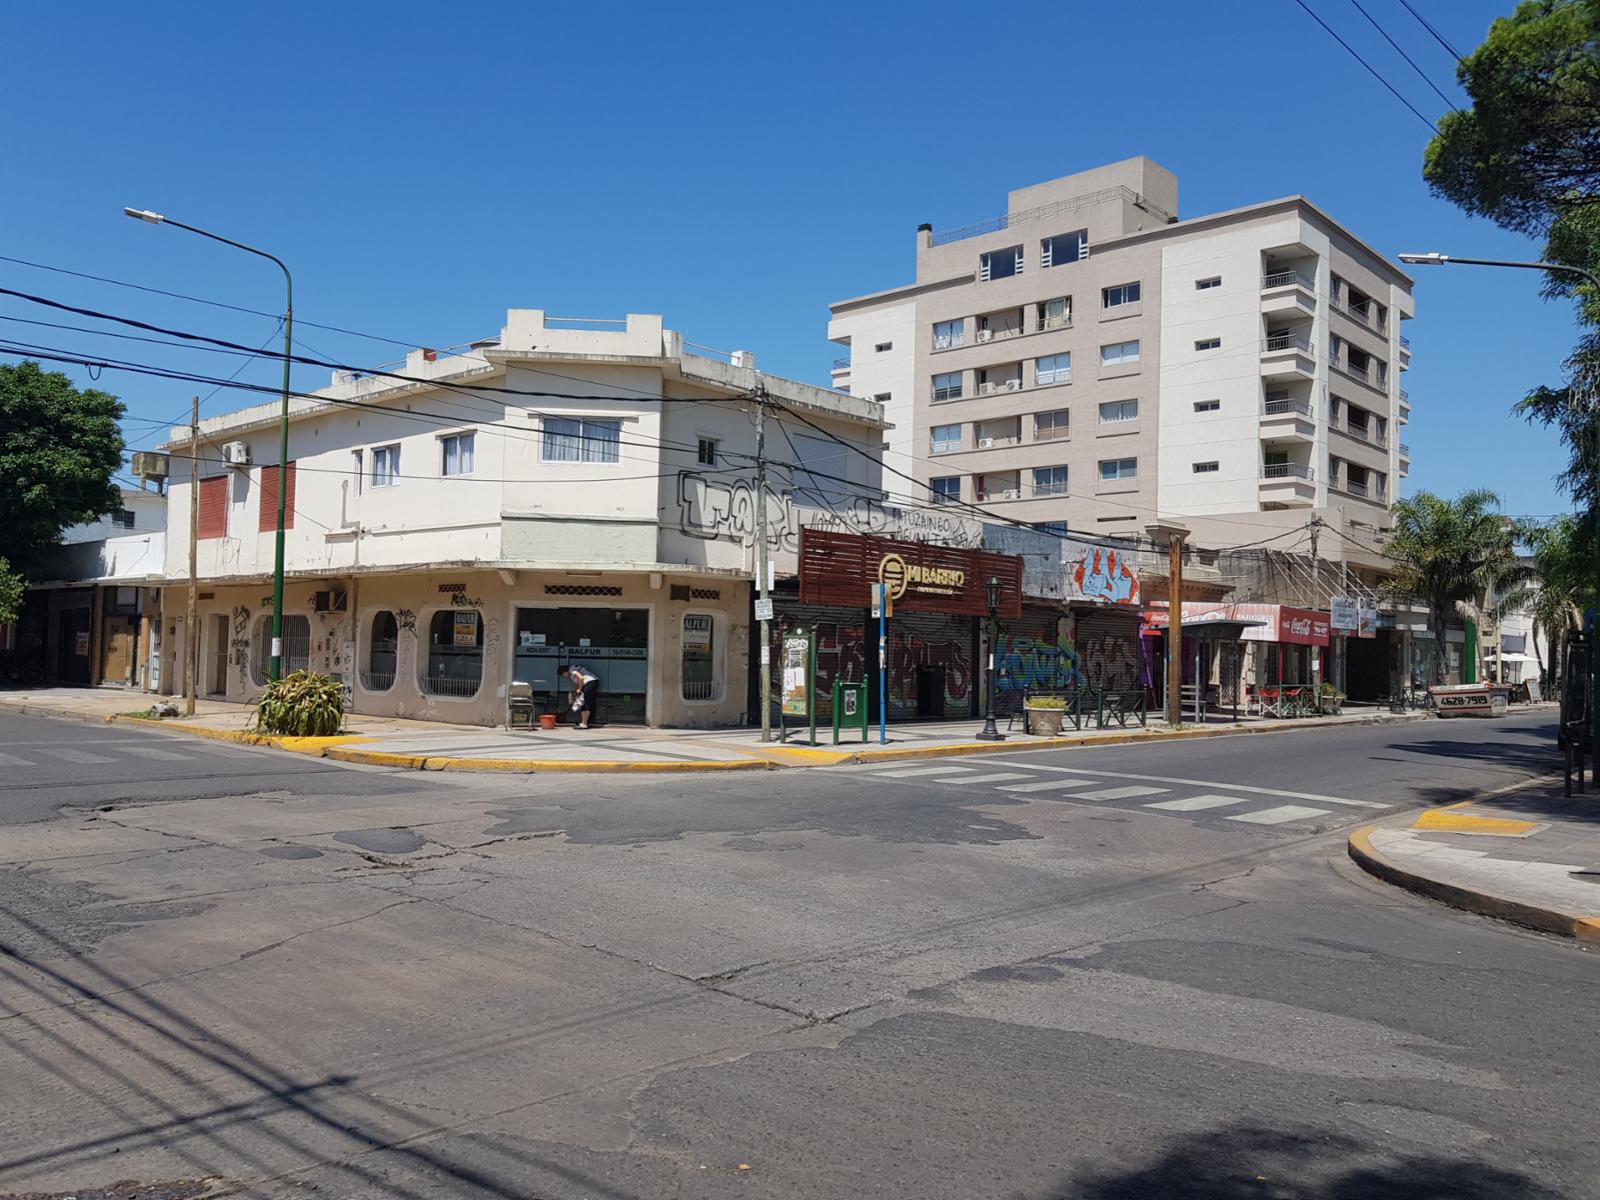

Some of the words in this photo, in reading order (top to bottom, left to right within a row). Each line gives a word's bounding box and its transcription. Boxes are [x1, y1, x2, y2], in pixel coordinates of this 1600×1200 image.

[907, 565, 921, 582] MI
[922, 567, 965, 586] BARRIO
[1291, 617, 1311, 635] Coca-Cola
[1441, 695, 1488, 706] 4628-7919
